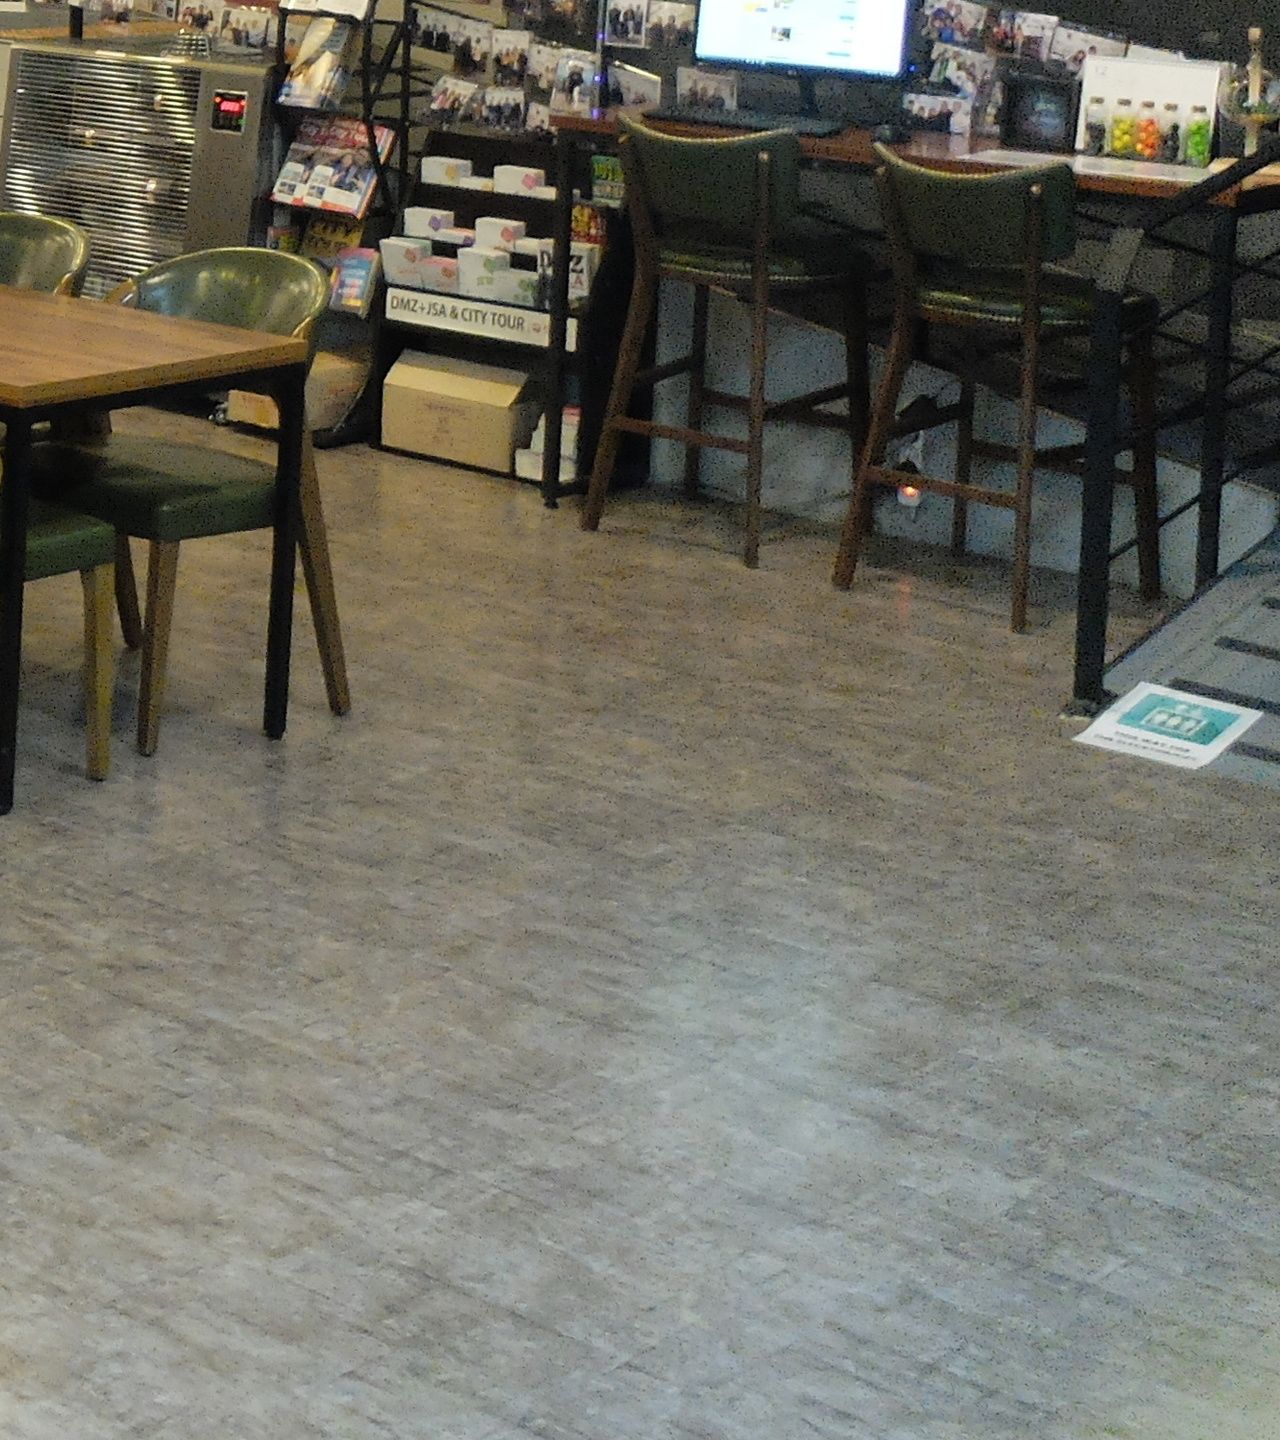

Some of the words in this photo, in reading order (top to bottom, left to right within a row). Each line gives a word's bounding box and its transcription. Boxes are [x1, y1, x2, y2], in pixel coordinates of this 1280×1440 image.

[390, 295, 447, 318] DMZ+JSA
[449, 305, 459, 320] &
[461, 307, 488, 325] CITY
[490, 312, 525, 331] TOUR
